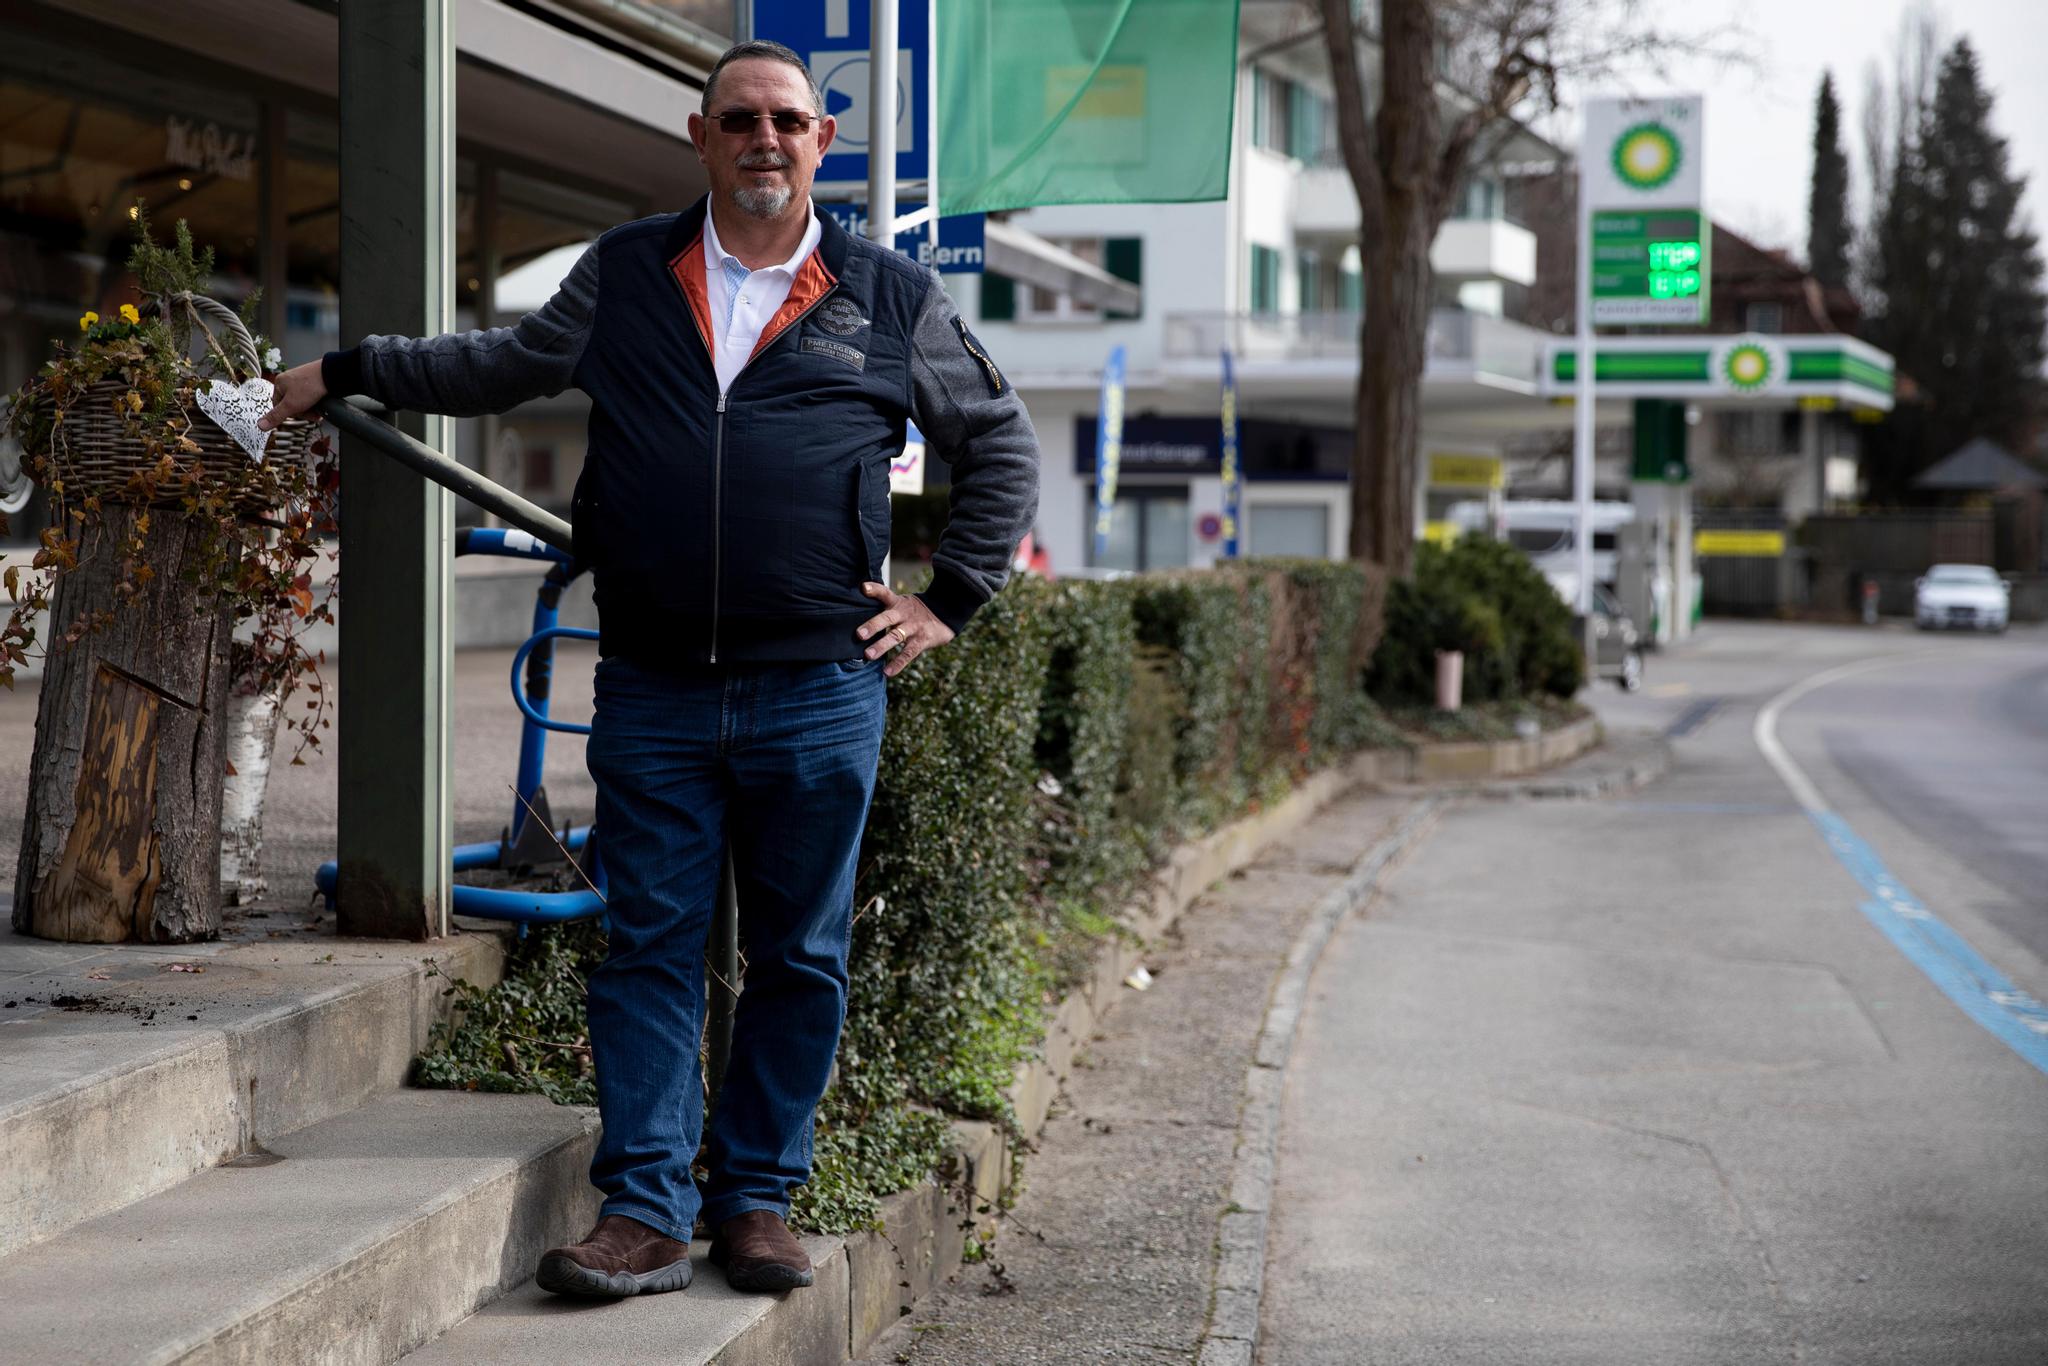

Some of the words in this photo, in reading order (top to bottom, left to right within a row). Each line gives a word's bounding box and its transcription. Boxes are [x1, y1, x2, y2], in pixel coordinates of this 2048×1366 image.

[917, 241, 982, 265] Bern
[830, 304, 850, 314] PME
[808, 339, 827, 348] PME
[828, 343, 860, 359] LEGEND
